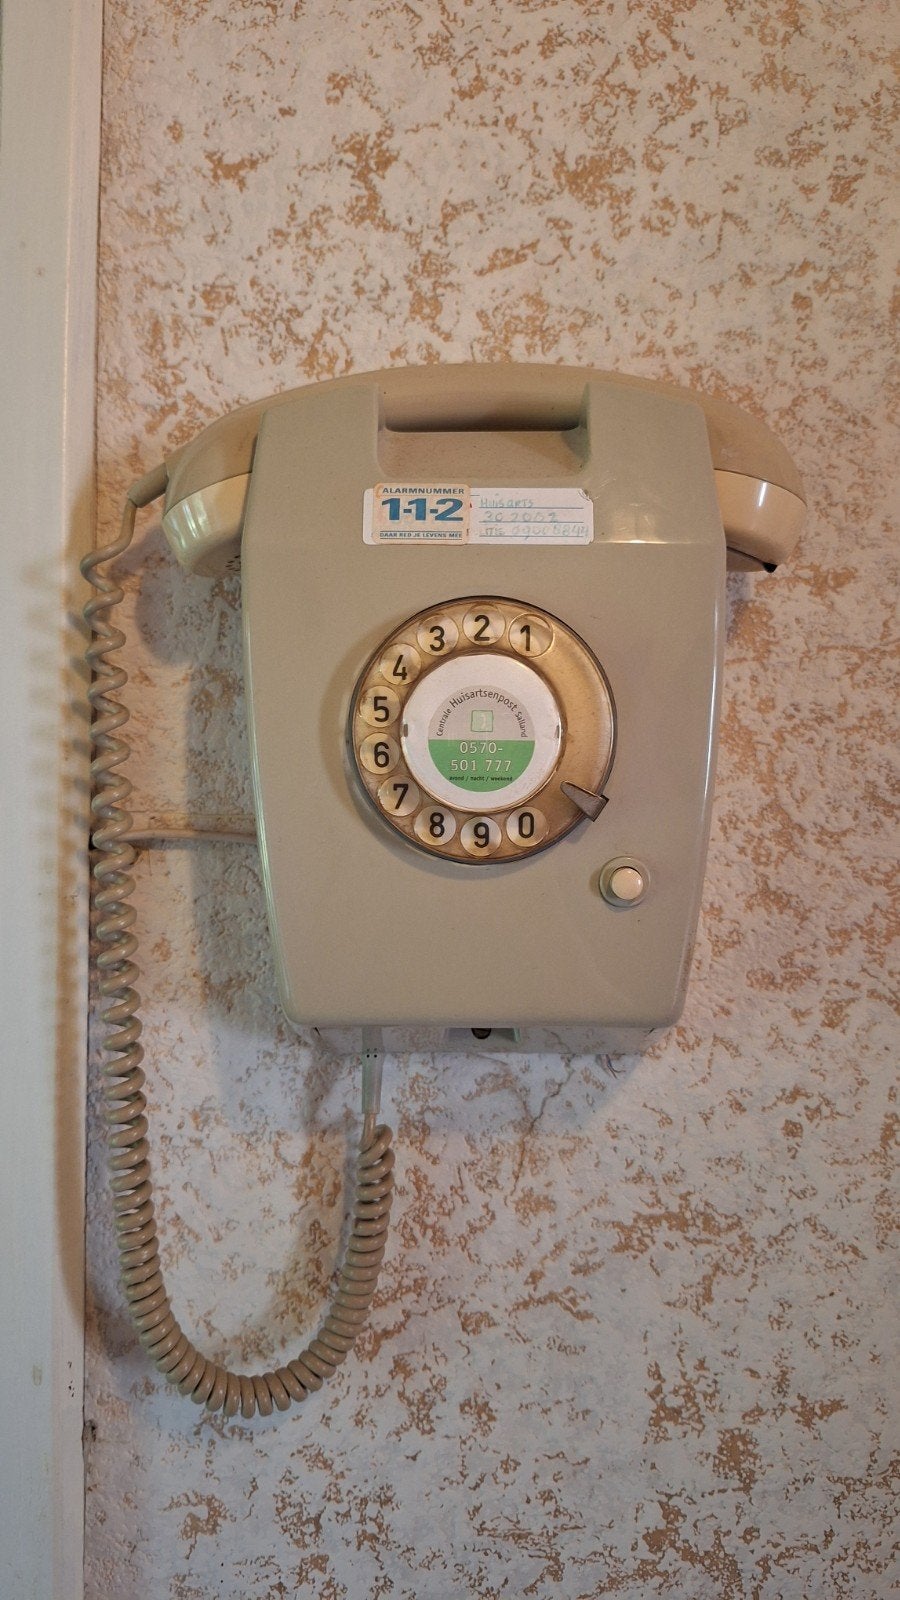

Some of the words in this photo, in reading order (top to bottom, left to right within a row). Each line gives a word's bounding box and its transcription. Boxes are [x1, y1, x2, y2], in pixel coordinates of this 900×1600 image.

[382, 487, 465, 495] ALARMNUMMER
[381, 497, 464, 522] 1-1-2
[428, 625, 445, 651] 3
[473, 614, 491, 642] 2
[519, 624, 532, 652] 1
[392, 654, 408, 681] 4
[372, 695, 390, 723] 5
[436, 708, 452, 737] Centrale
[449, 689, 518, 712] Huisartsenpost
[515, 711, 529, 738] Salland
[373, 741, 390, 769] 6
[460, 741, 504, 754] 0570-
[451, 759, 477, 771] 501
[485, 759, 512, 772] 777
[392, 783, 409, 810] 7
[429, 812, 445, 838] 8
[473, 822, 490, 849] 9
[517, 811, 535, 839] 0
